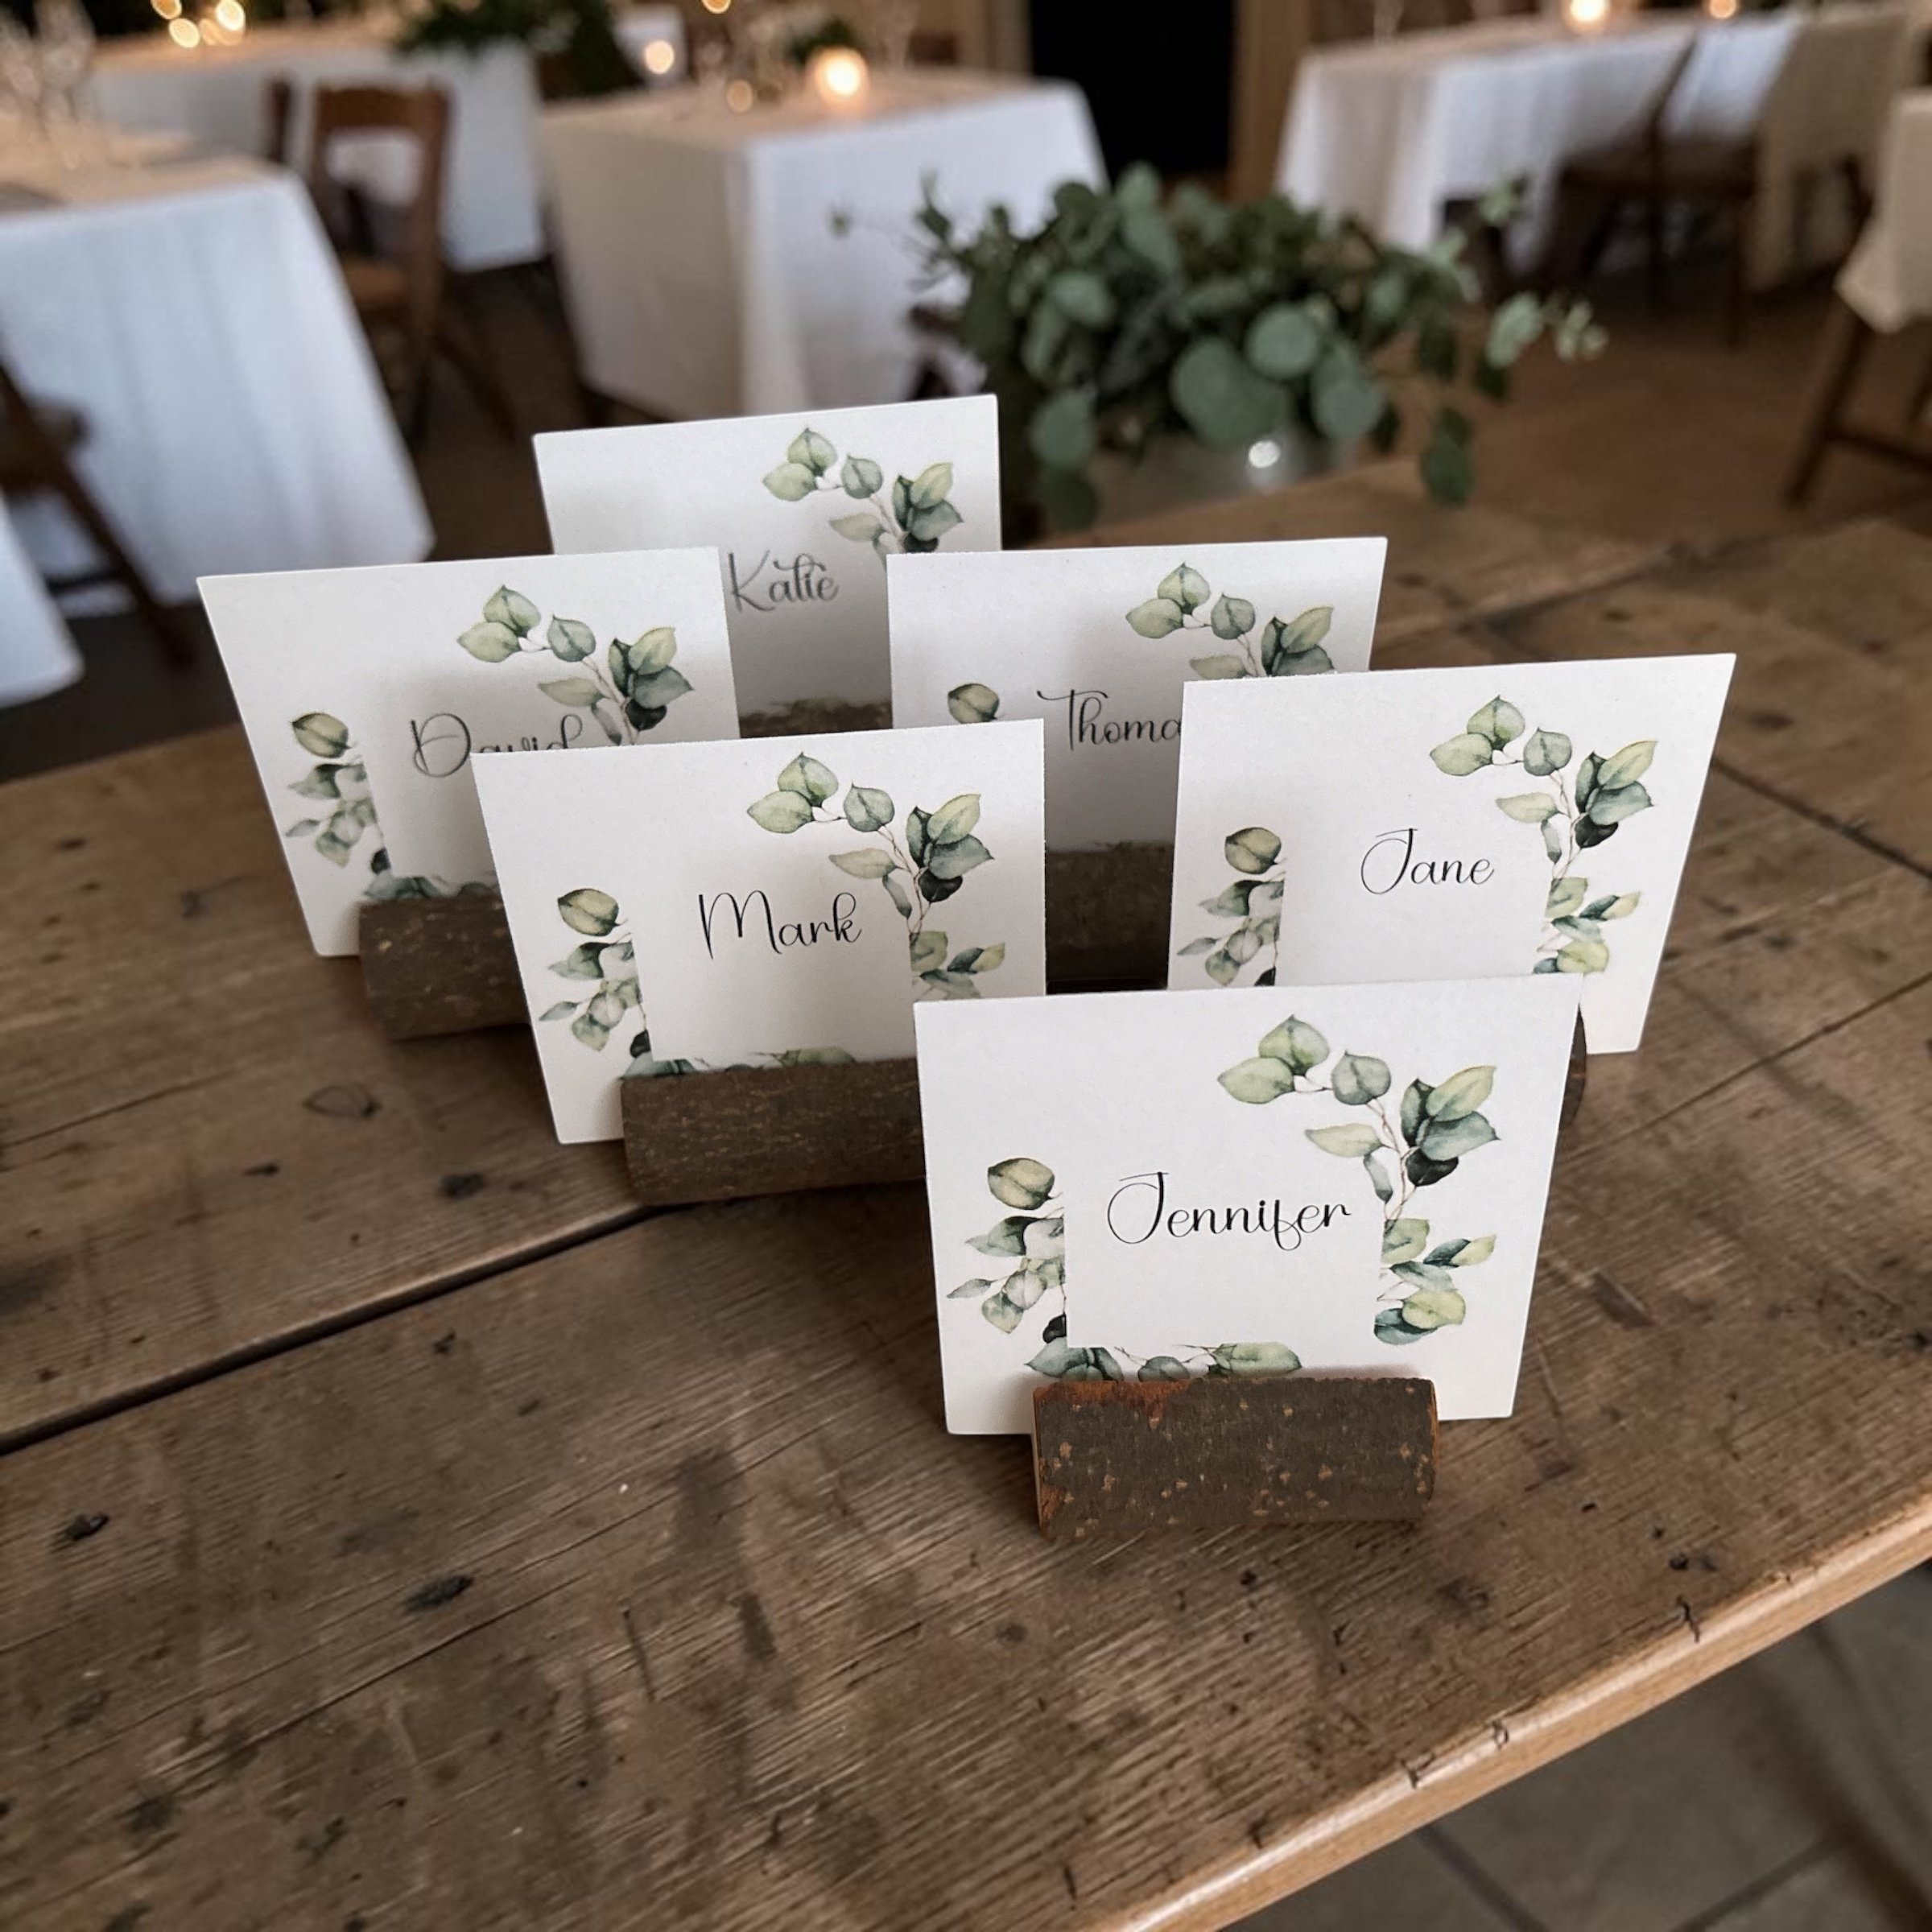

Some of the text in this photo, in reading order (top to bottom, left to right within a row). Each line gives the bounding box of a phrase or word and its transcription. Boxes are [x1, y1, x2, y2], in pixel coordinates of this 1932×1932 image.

[728, 551, 839, 613] Katie
[1037, 689, 1181, 751] Thoma
[1361, 828, 1495, 894] Jane
[699, 890, 861, 960] Mark
[1107, 1171, 1352, 1251] Jennifer
